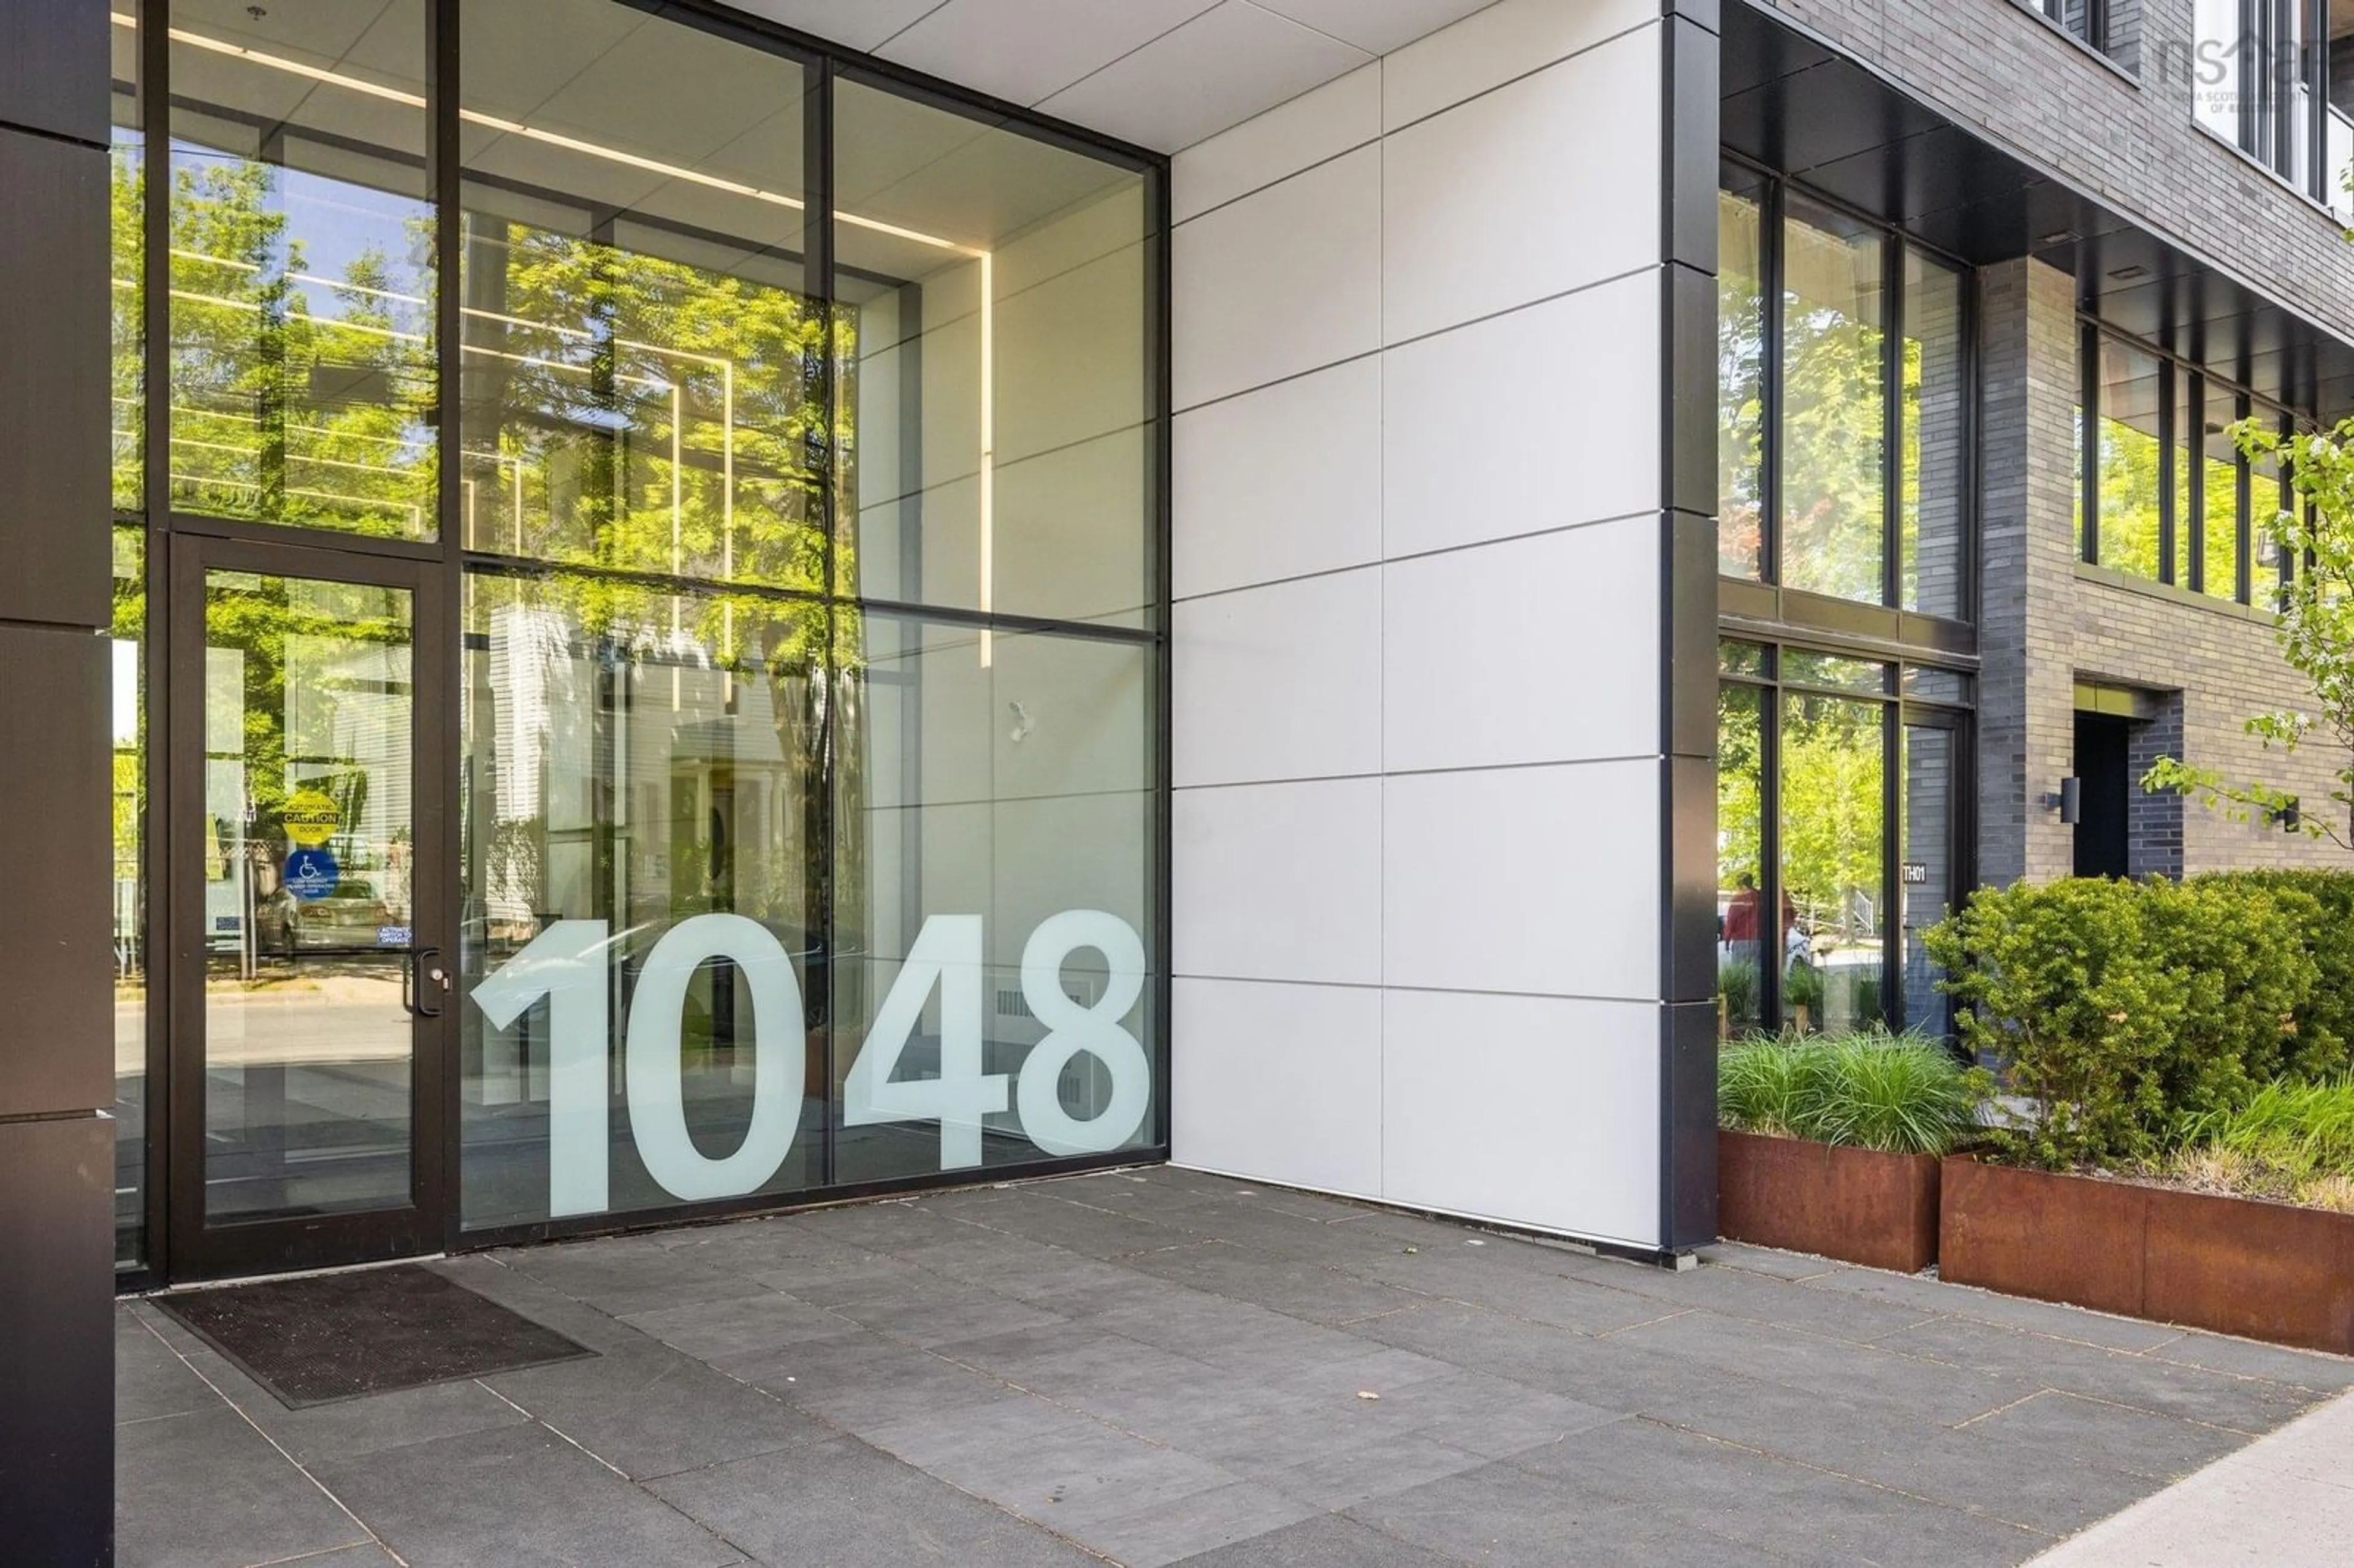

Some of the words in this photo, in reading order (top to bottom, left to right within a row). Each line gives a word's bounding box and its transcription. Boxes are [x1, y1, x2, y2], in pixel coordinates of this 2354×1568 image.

[284, 813, 337, 823] CAUTION
[1903, 866, 1925, 881] TH01
[470, 909, 1150, 1218] 1048
